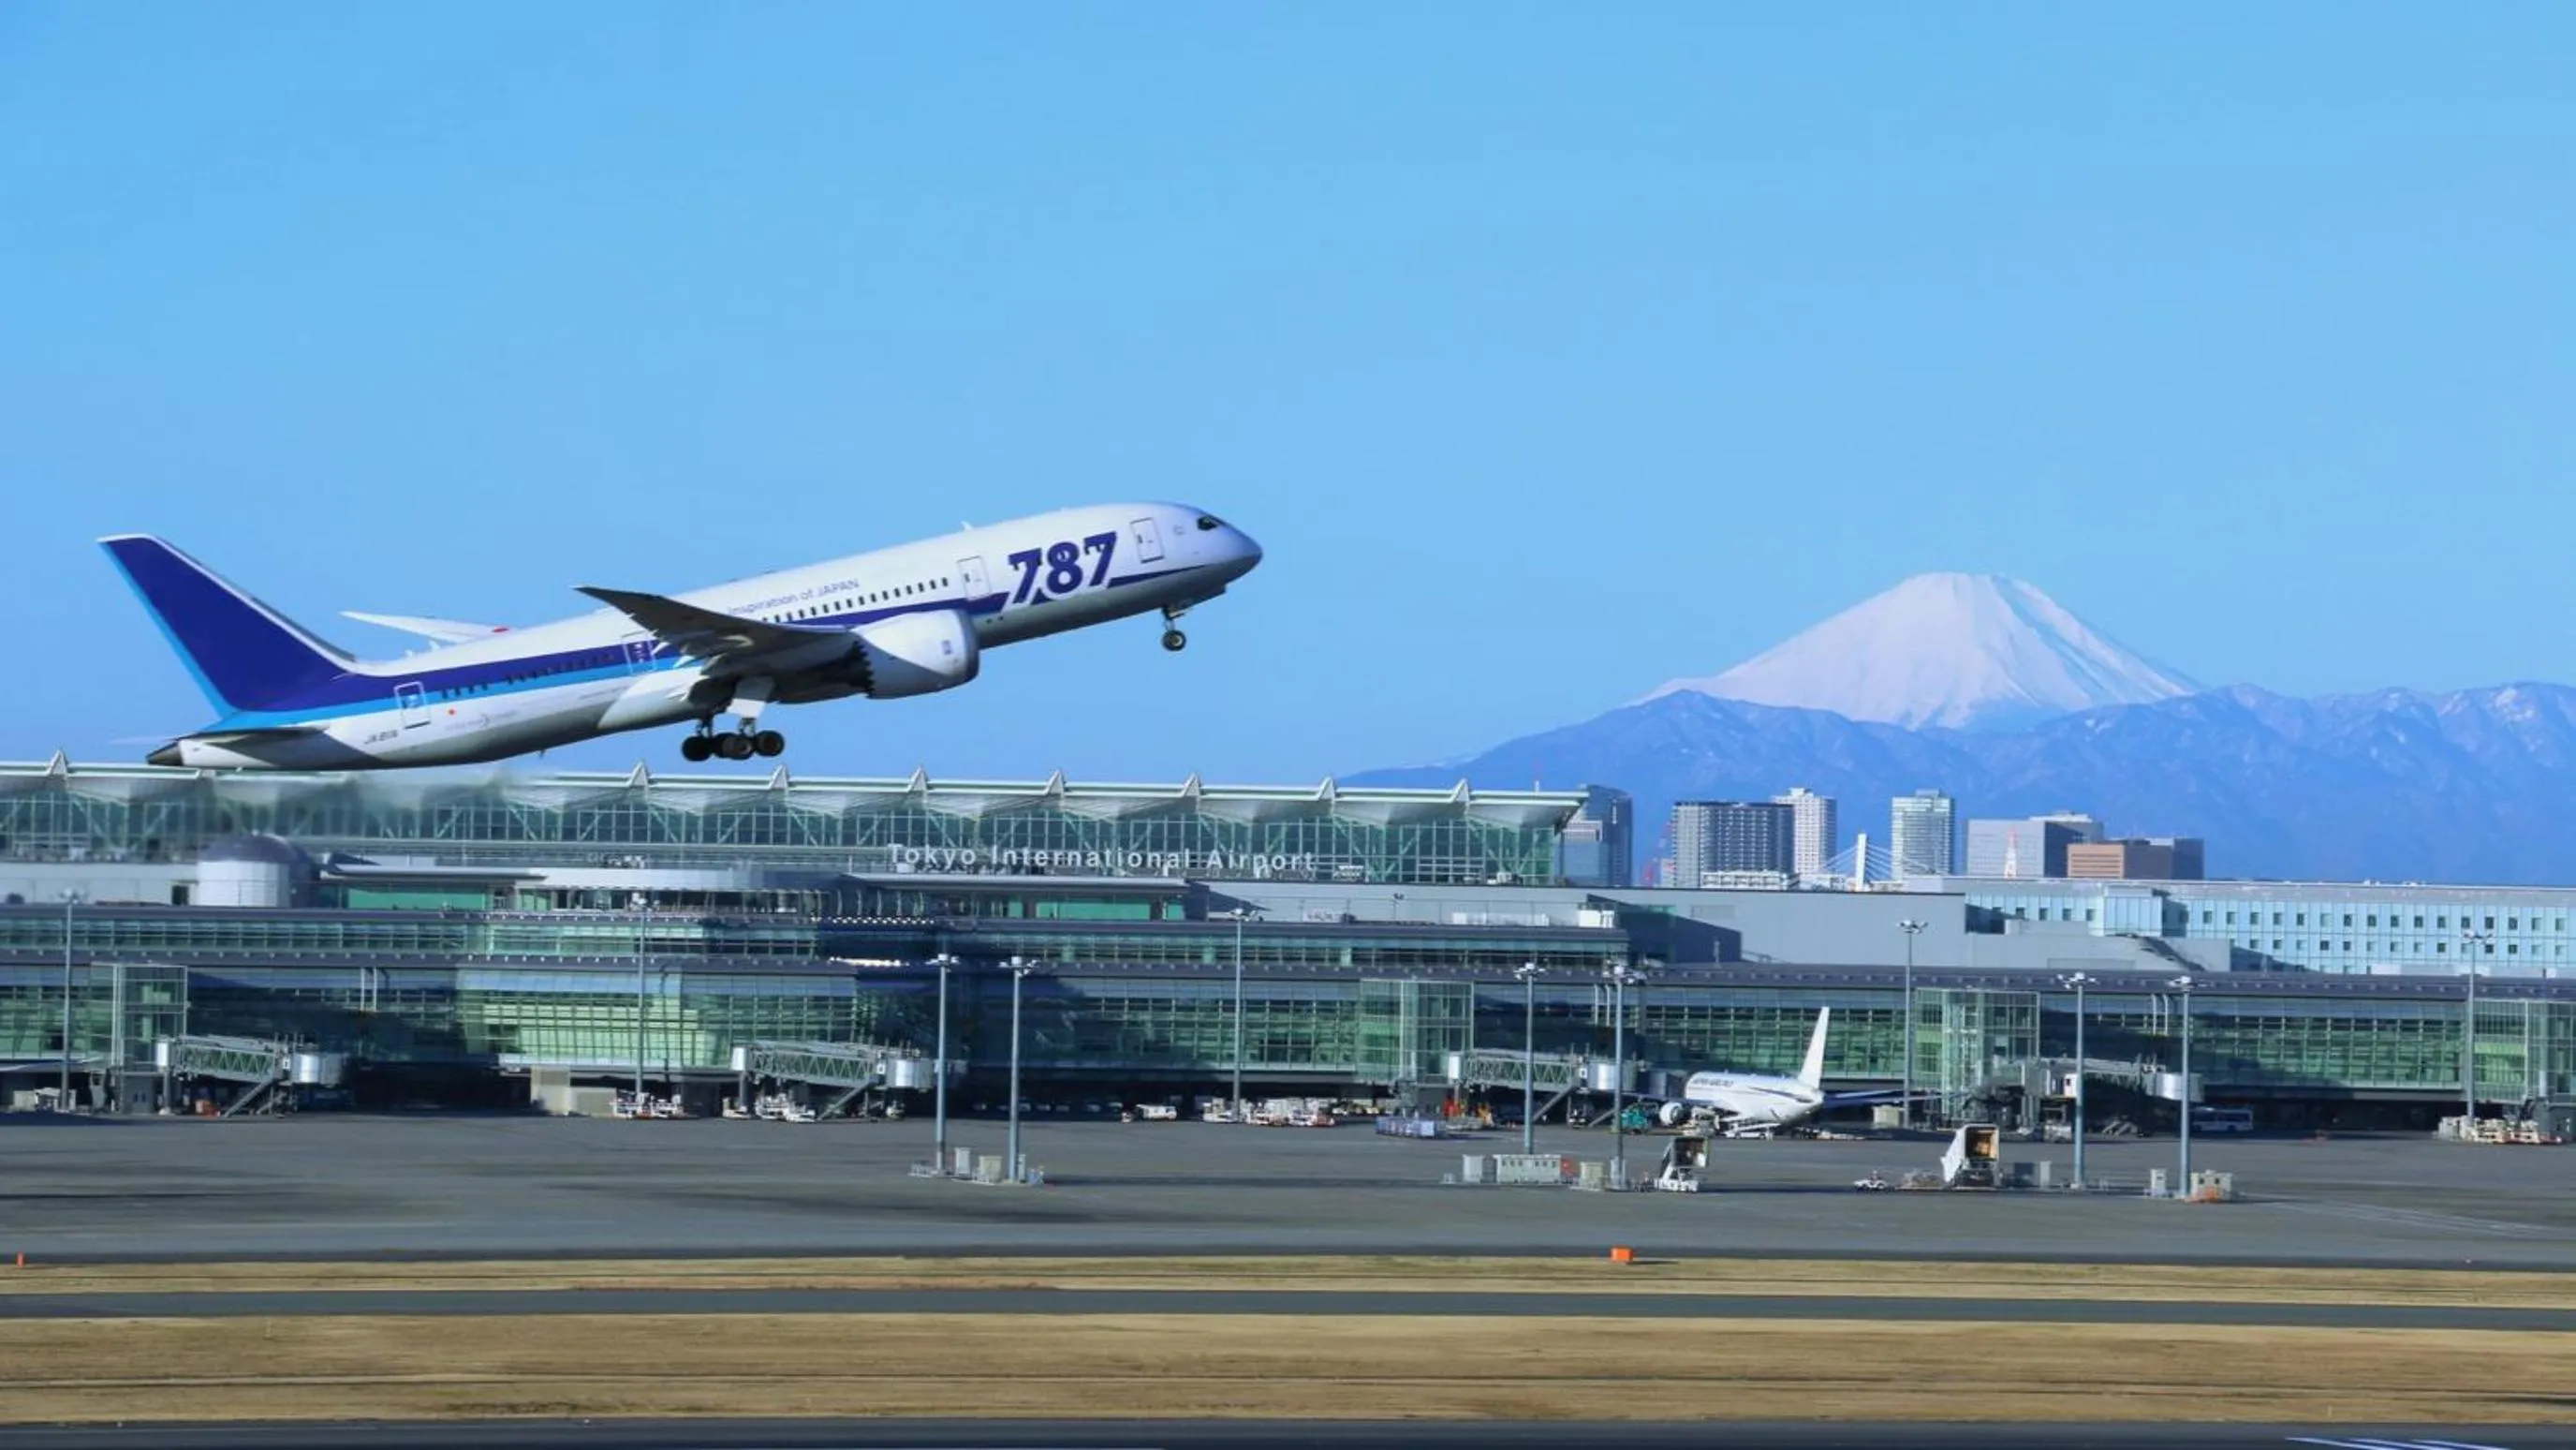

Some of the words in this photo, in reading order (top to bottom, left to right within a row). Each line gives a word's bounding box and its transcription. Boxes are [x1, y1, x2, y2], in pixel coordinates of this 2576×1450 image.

[1008, 530, 1117, 604] 787
[817, 578, 860, 596] JAPAN
[888, 844, 977, 869] Tokyo
[991, 845, 1191, 869] International
[1206, 849, 1315, 876] Airport
